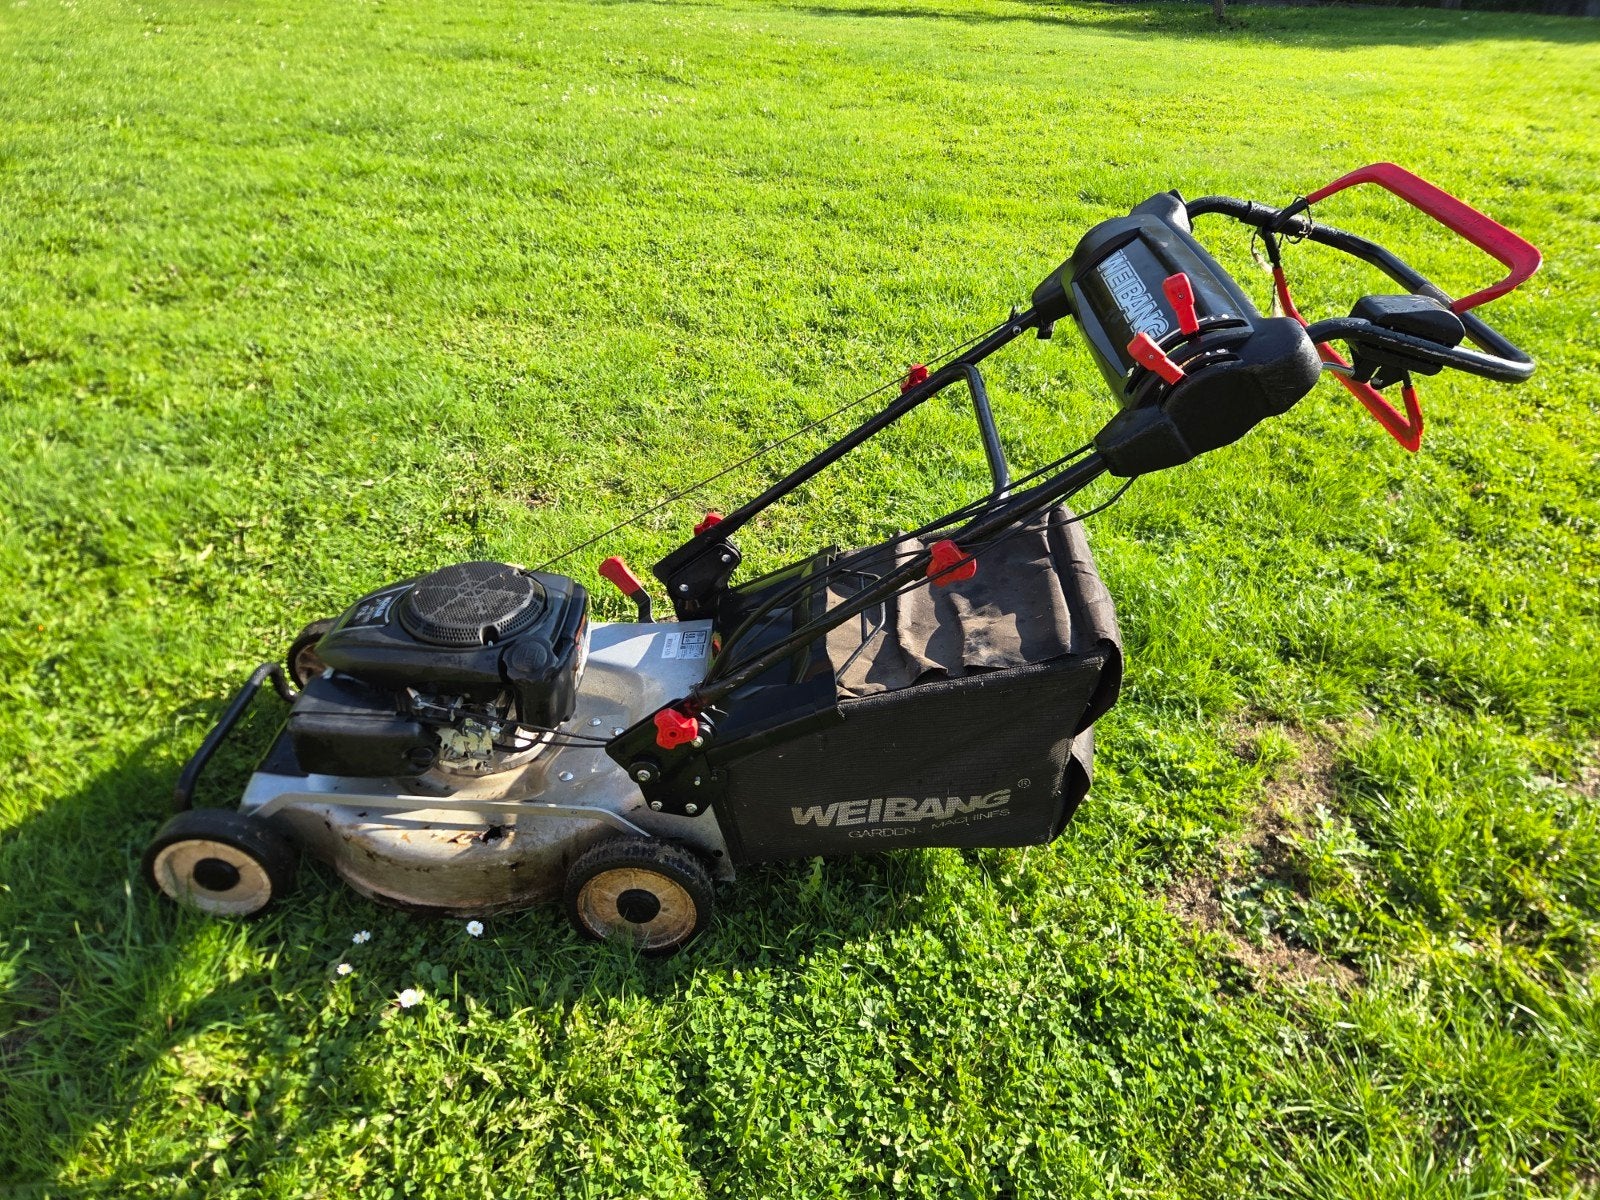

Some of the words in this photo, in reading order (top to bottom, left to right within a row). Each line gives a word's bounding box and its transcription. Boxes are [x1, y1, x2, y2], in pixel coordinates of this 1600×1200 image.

[1097, 249, 1169, 339] WEIBANG
[791, 789, 1011, 827] WEIBANG
[848, 826, 916, 839] GARDEN
